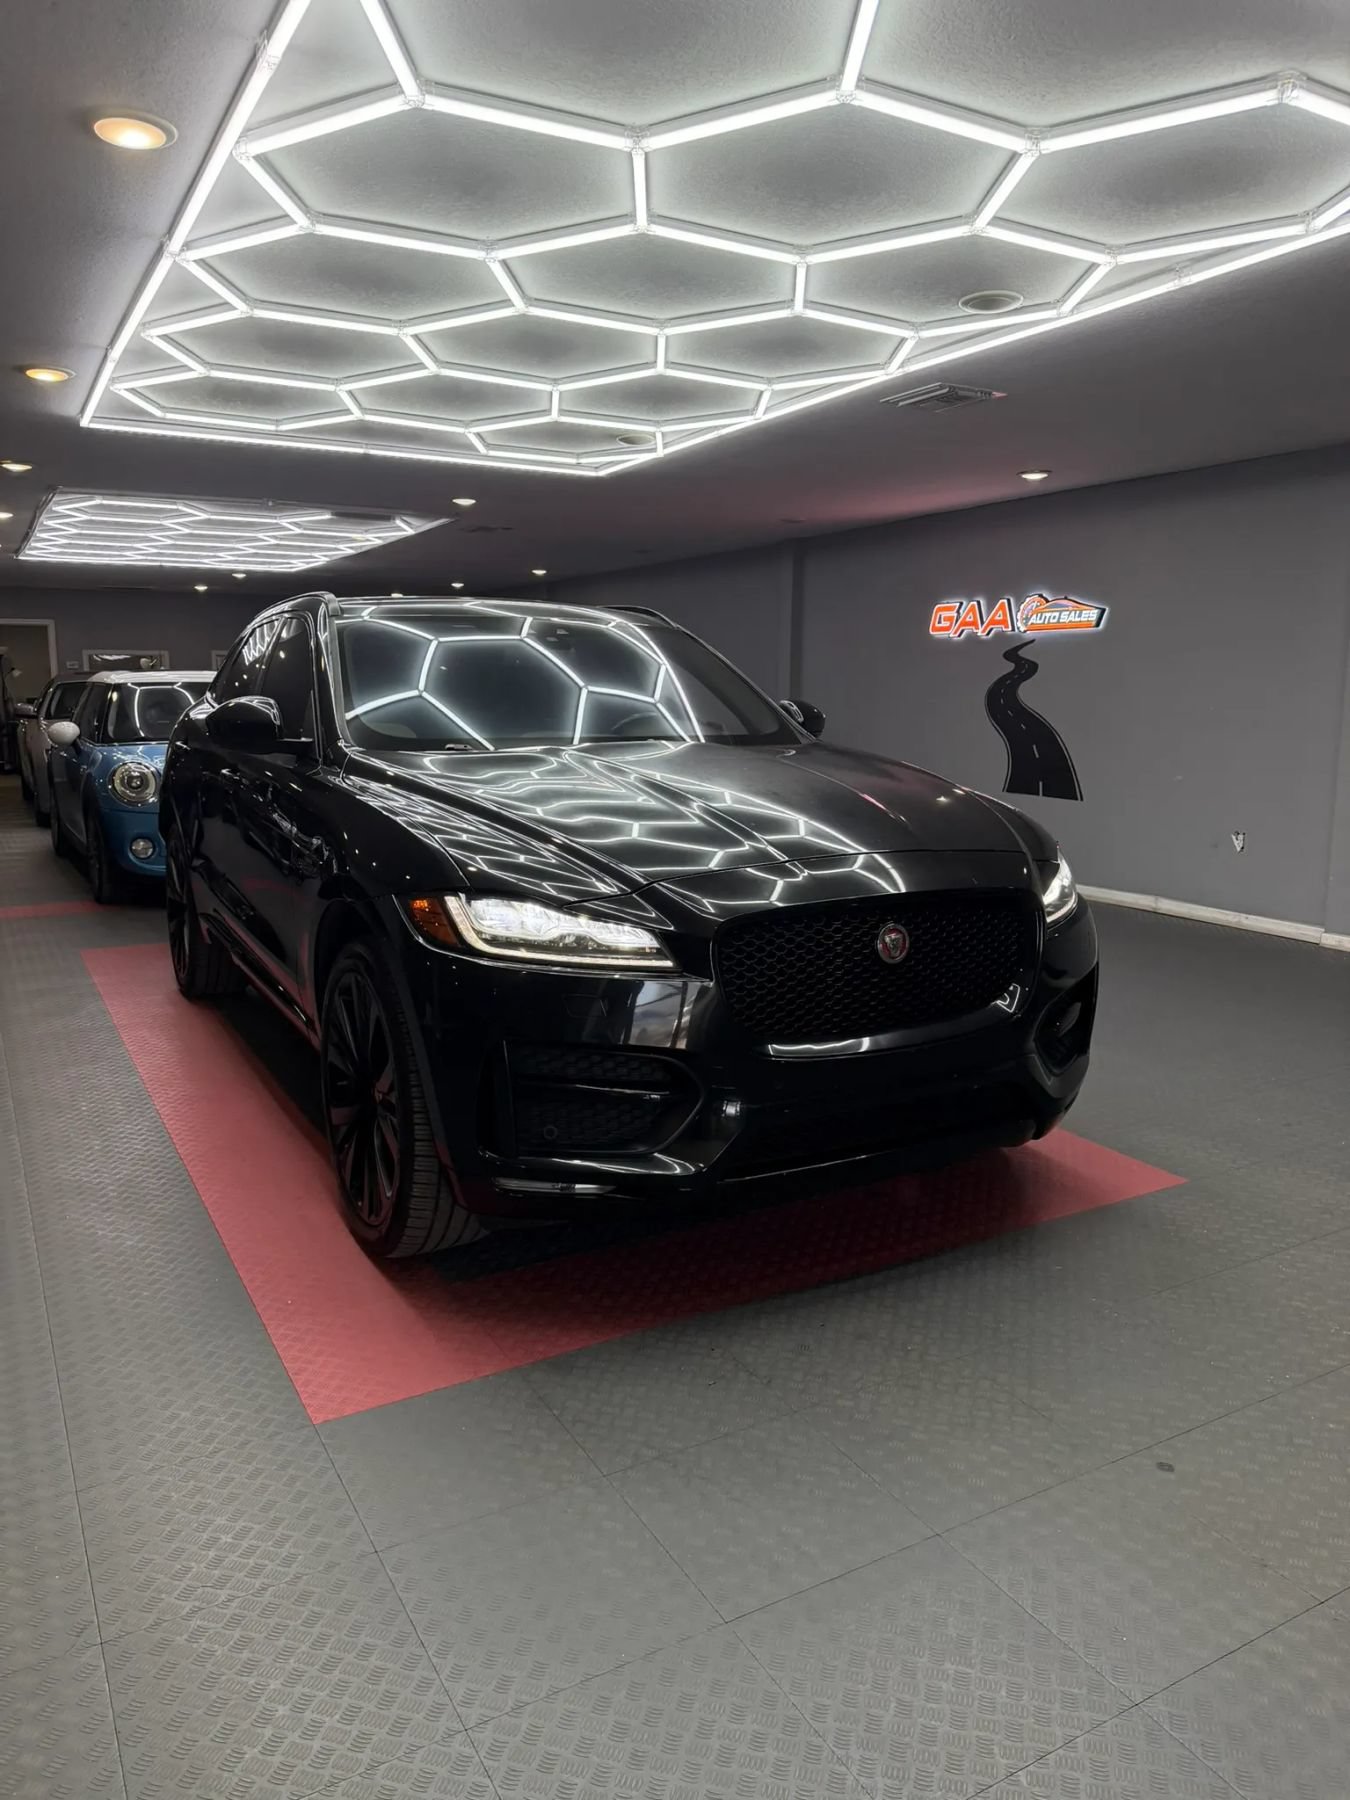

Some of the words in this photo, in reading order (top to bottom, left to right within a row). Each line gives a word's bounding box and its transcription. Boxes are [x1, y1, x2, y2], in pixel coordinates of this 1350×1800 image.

[930, 598, 1012, 637] GAA
[1029, 612, 1059, 624] AUTO
[1060, 609, 1098, 623] SALES
